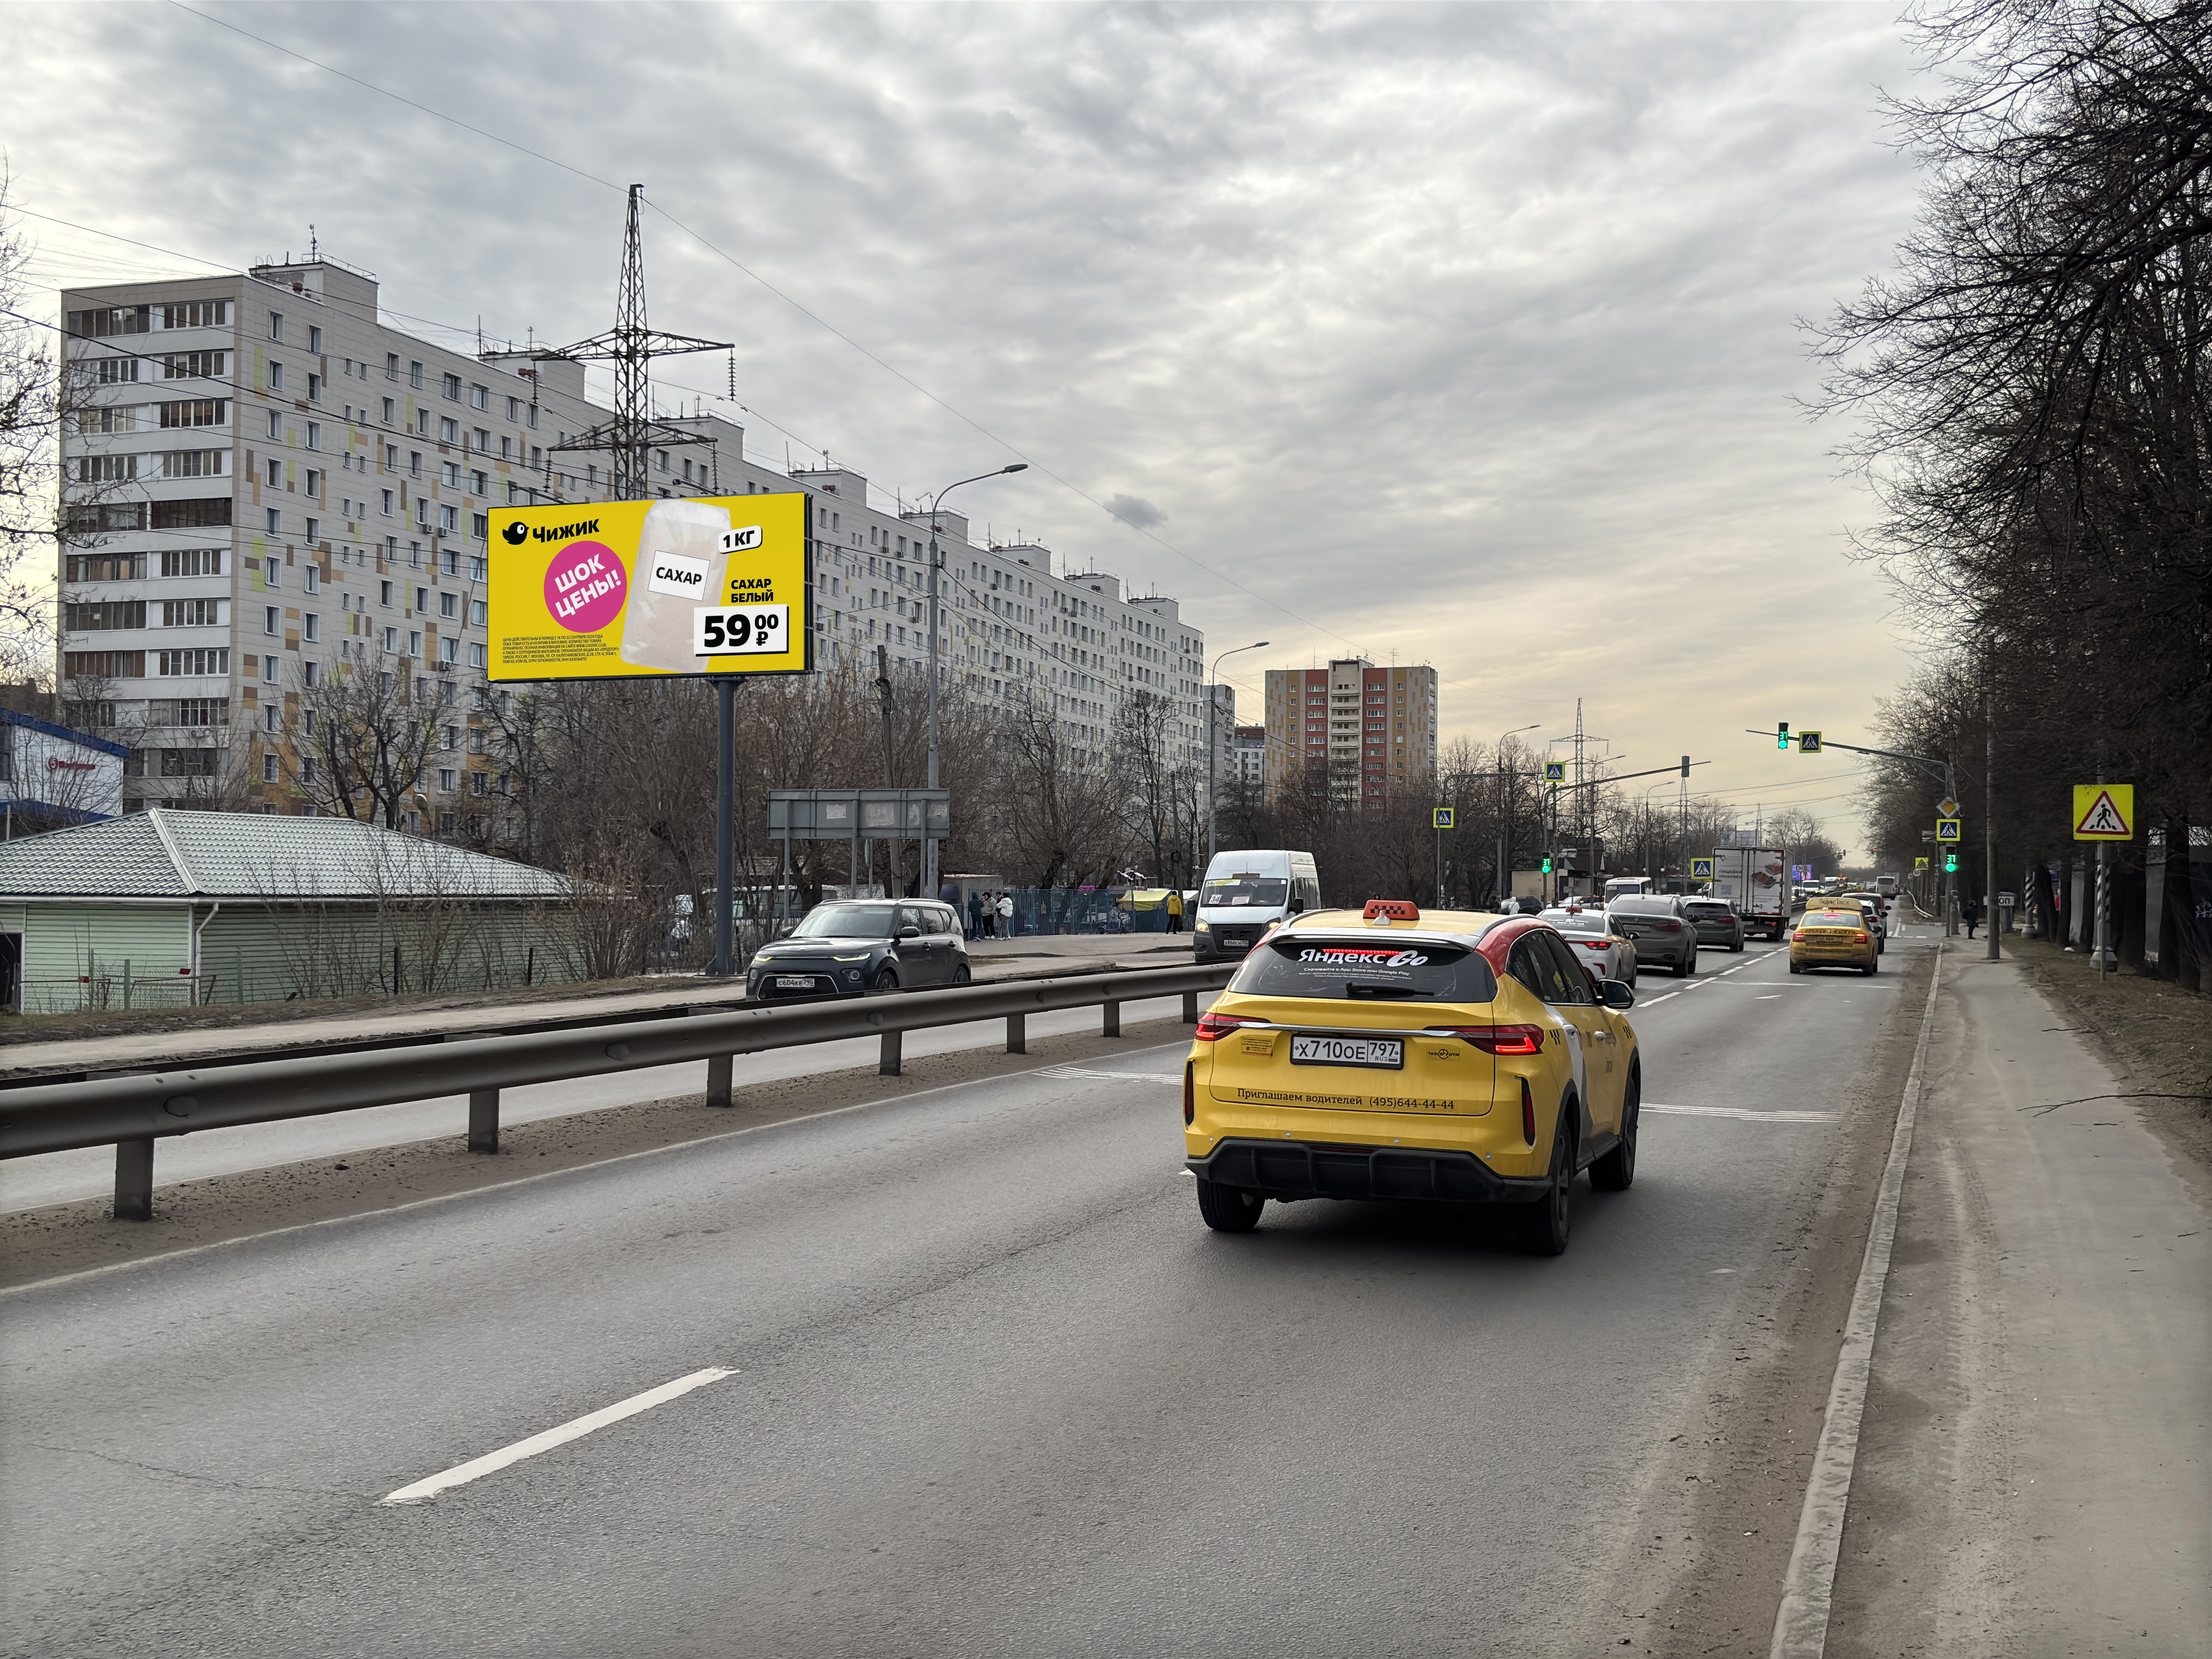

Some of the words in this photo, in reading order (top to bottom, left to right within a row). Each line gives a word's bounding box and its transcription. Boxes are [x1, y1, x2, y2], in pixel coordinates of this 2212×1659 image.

[533, 519, 600, 543] Чижик
[723, 535, 730, 548] 1
[735, 530, 754, 546] КГ
[554, 553, 605, 593] ШОК
[656, 566, 702, 585] САХАР
[555, 569, 621, 618] ЦЕНЫ!
[731, 579, 771, 589] САХАР
[731, 589, 773, 603] БЕЛЫЙ
[704, 614, 750, 647] 59
[755, 614, 778, 629] 00
[1298, 949, 1386, 964] Яндекс
[1387, 950, 1428, 967] Go
[1369, 1042, 1396, 1056] 797
[1237, 1088, 1303, 1101] Приглашаем
[1306, 1095, 1362, 1105] водителей
[1370, 1096, 1454, 1109] (495)644-44-44
